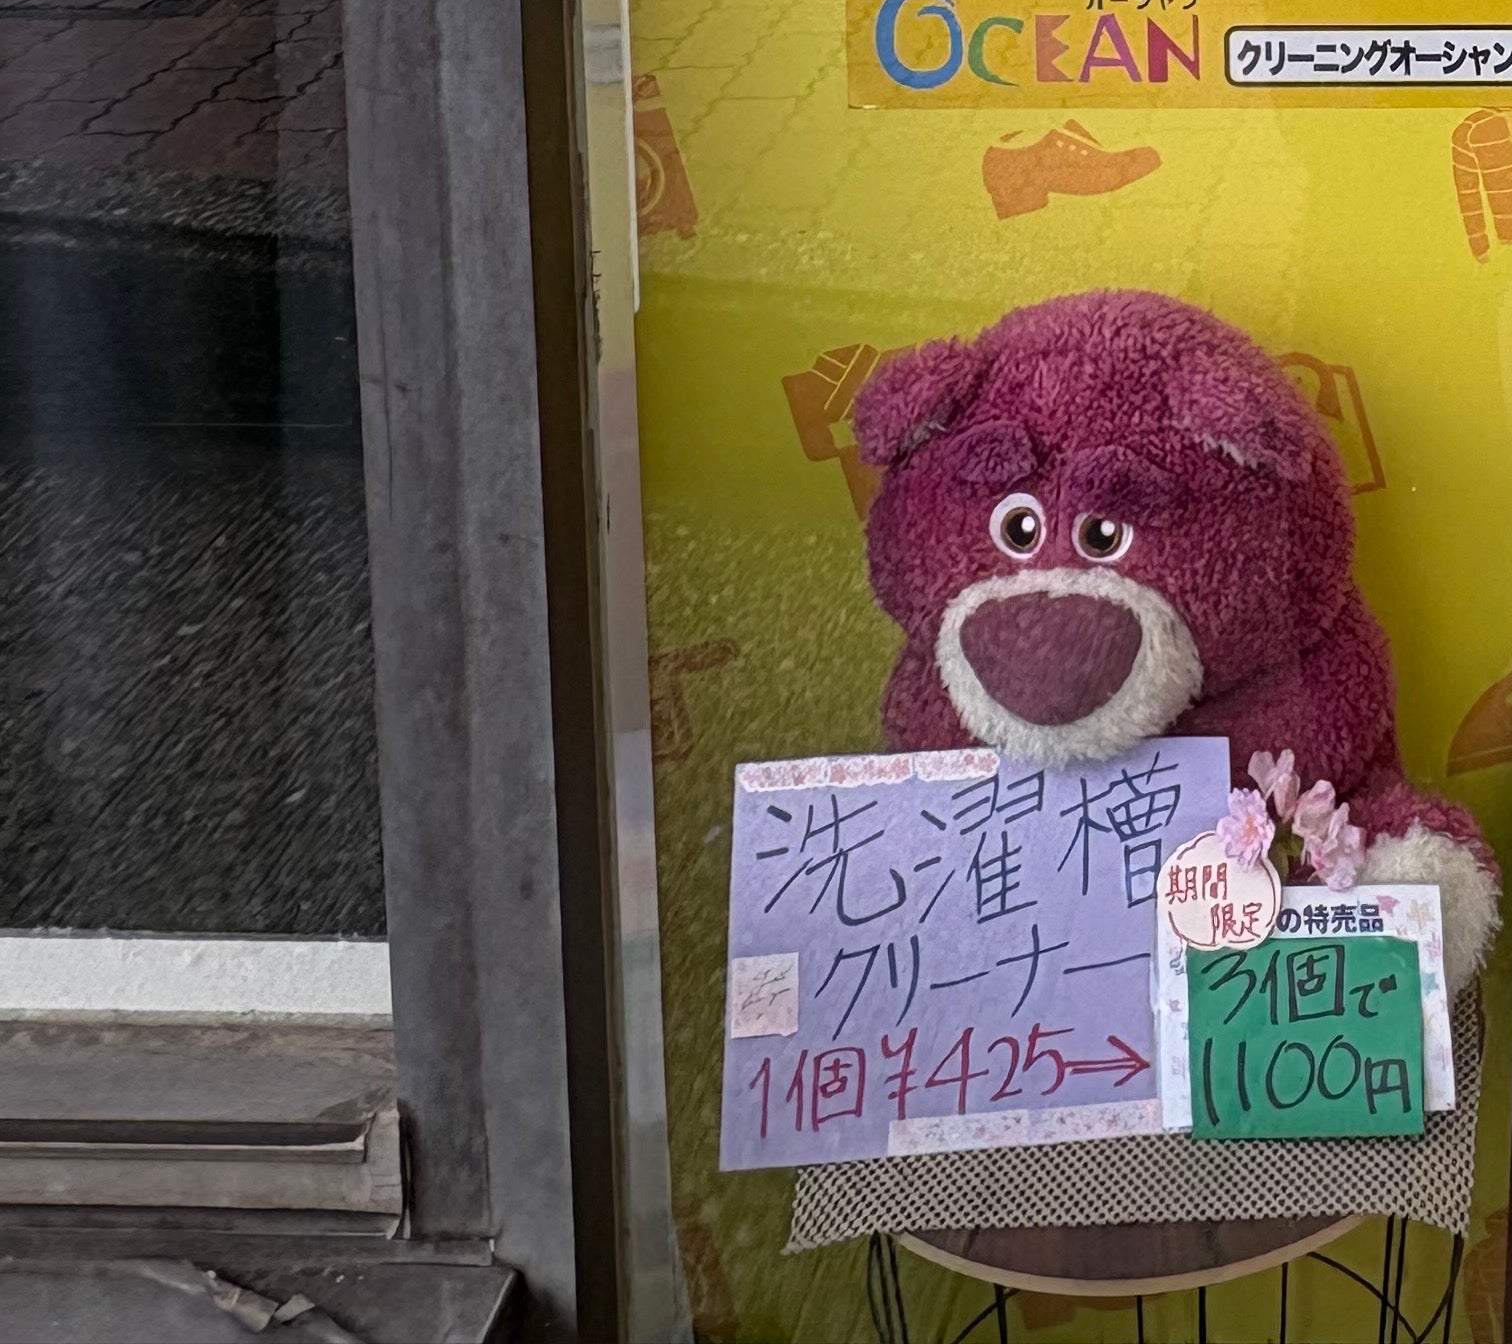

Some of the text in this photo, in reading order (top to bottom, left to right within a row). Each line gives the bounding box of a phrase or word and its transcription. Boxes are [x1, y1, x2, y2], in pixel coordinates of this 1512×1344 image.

[755, 750, 1181, 928] 洗濯槽
[1164, 862, 1229, 905] 期間
[1209, 902, 1263, 947] 限定
[1275, 904, 1384, 935] の特売品
[814, 924, 1152, 1042] クリーナー
[1201, 943, 1397, 1026] 3個で
[1203, 1033, 1412, 1116] 1100円
